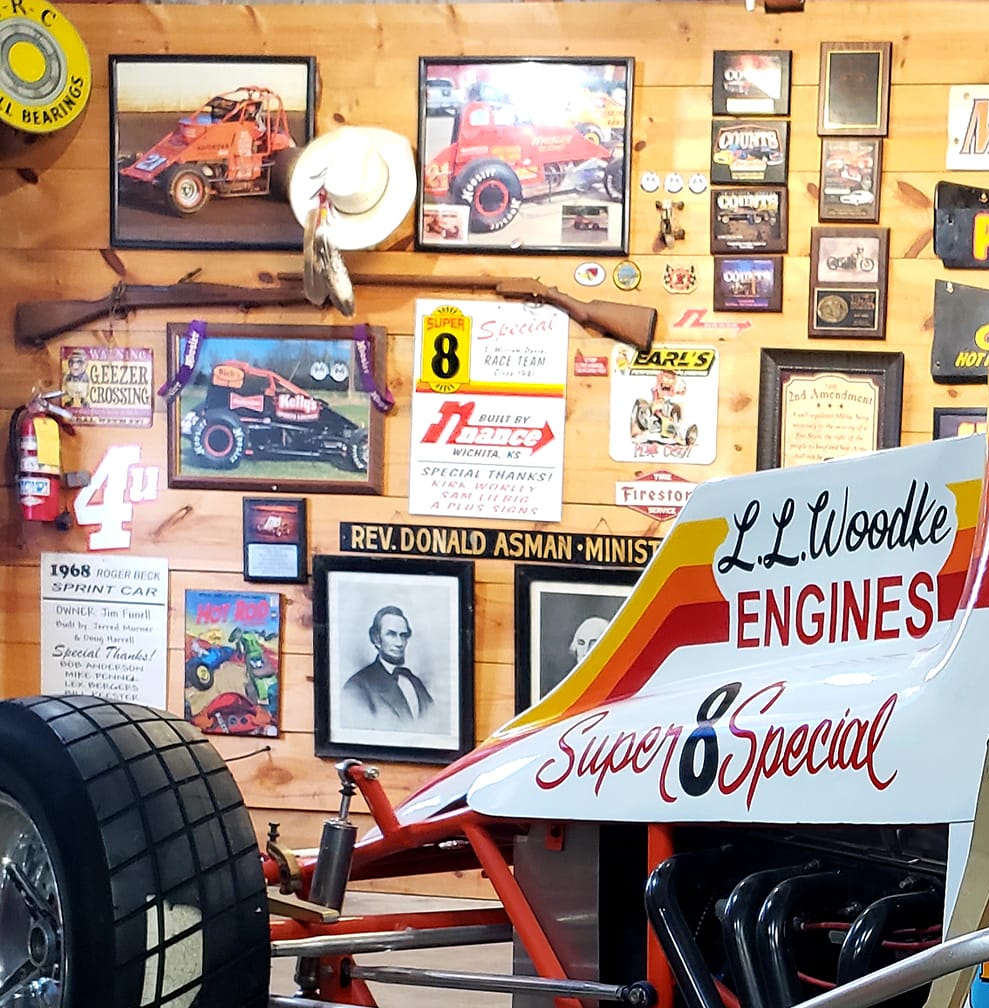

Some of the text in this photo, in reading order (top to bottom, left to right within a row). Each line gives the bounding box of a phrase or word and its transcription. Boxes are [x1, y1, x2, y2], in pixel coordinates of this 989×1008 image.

[22, 75, 84, 125] BEARINGS
[426, 317, 465, 331] SUPER
[431, 333, 460, 379] 8
[484, 355, 546, 367] RACE TEAM
[633, 350, 710, 367] EARL'S
[90, 365, 149, 385] GEEZER
[89, 386, 149, 405] CROSSING
[789, 388, 873, 406] 2nd Amendment
[478, 413, 532, 425] BUILT BY
[506, 450, 521, 460] KS
[421, 467, 553, 483] SPECIAL THANKS!
[351, 525, 396, 552] REV.
[400, 527, 487, 556] DONALD
[493, 531, 573, 561] ASMAN
[50, 563, 161, 581] 1968 ROGER BECK
[51, 582, 158, 597] SPRINT CAR
[196, 602, 231, 625] HOT
[736, 571, 935, 649] ENGINES
[52, 644, 157, 662] Special Thanks!
[535, 680, 899, 813] Super 8 Special
